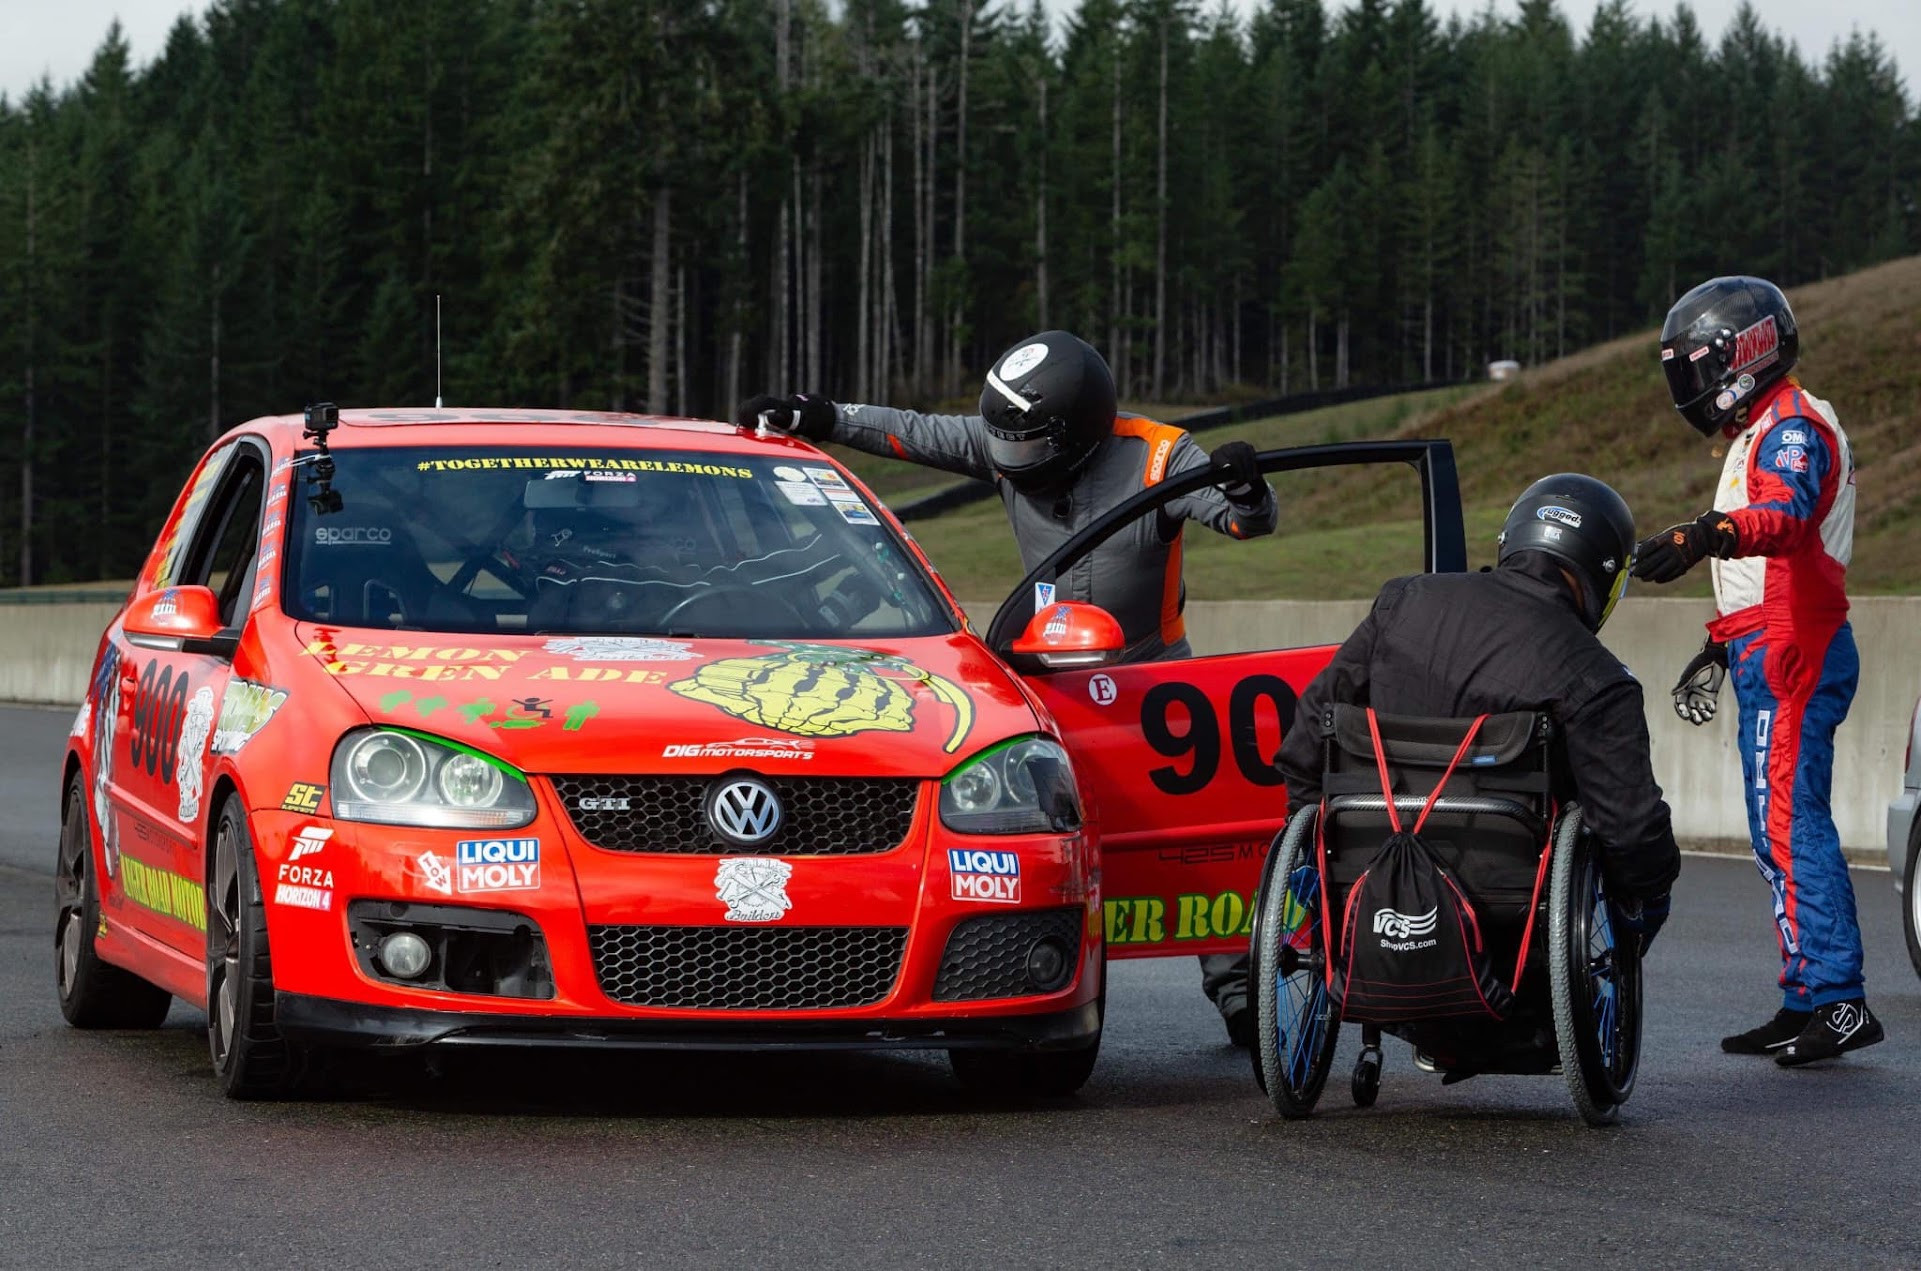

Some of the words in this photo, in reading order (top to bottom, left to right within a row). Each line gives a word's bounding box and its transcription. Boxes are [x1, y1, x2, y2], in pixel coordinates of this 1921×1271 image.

[417, 457, 753, 479] #TOGETHERWEARELEMONS
[299, 641, 534, 662] LEMON
[1093, 677, 1113, 701] E
[131, 659, 189, 785] 900
[662, 745, 703, 758] DIG
[701, 748, 814, 760] MOTORSPORTS
[579, 797, 630, 811] GTI
[461, 841, 535, 864] LIQUI
[951, 850, 1017, 874] LIQUI
[278, 863, 334, 889] FORZA
[423, 857, 447, 887] TOW
[462, 864, 538, 889] MOLY
[275, 884, 321, 908] HORIZON
[321, 890, 332, 911] 4
[955, 875, 1020, 899] MOLY
